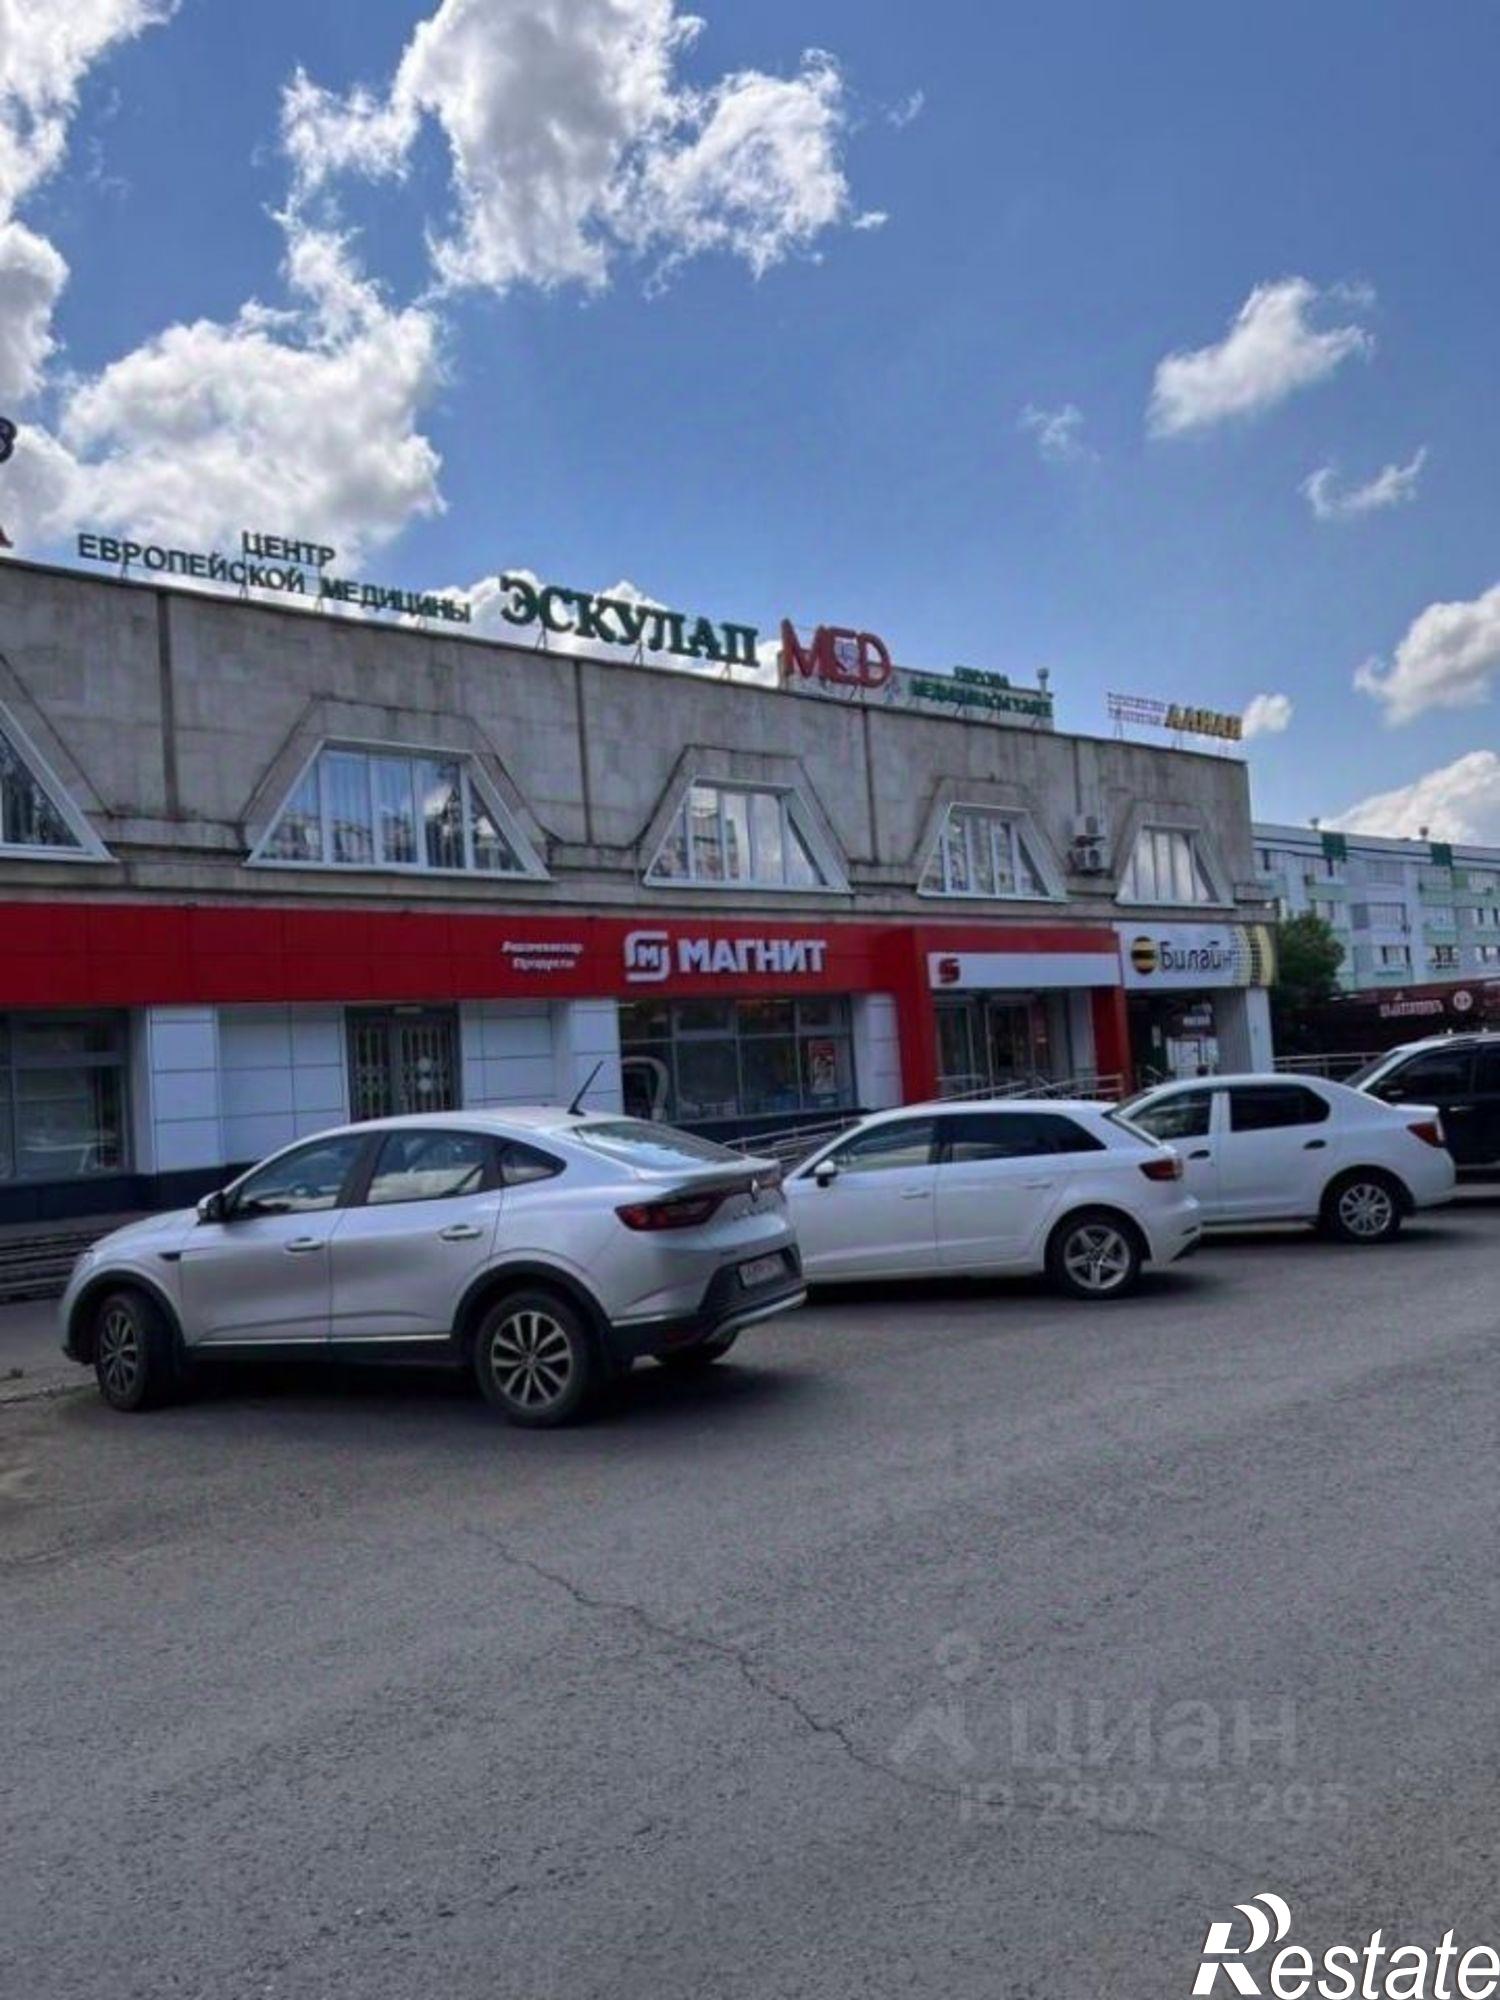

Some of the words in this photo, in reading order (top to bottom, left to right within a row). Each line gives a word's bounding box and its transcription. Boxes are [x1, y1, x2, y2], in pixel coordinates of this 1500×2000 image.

[77, 532, 306, 594] ЕВРОПЕЙСКОЙ
[319, 576, 472, 624] МЕДИЦИНЫ
[241, 530, 337, 567] ЦЕНТР
[500, 575, 760, 668] ЭСКУЛАП
[781, 618, 892, 688] MED
[677, 939, 828, 973] МАГНИТ
